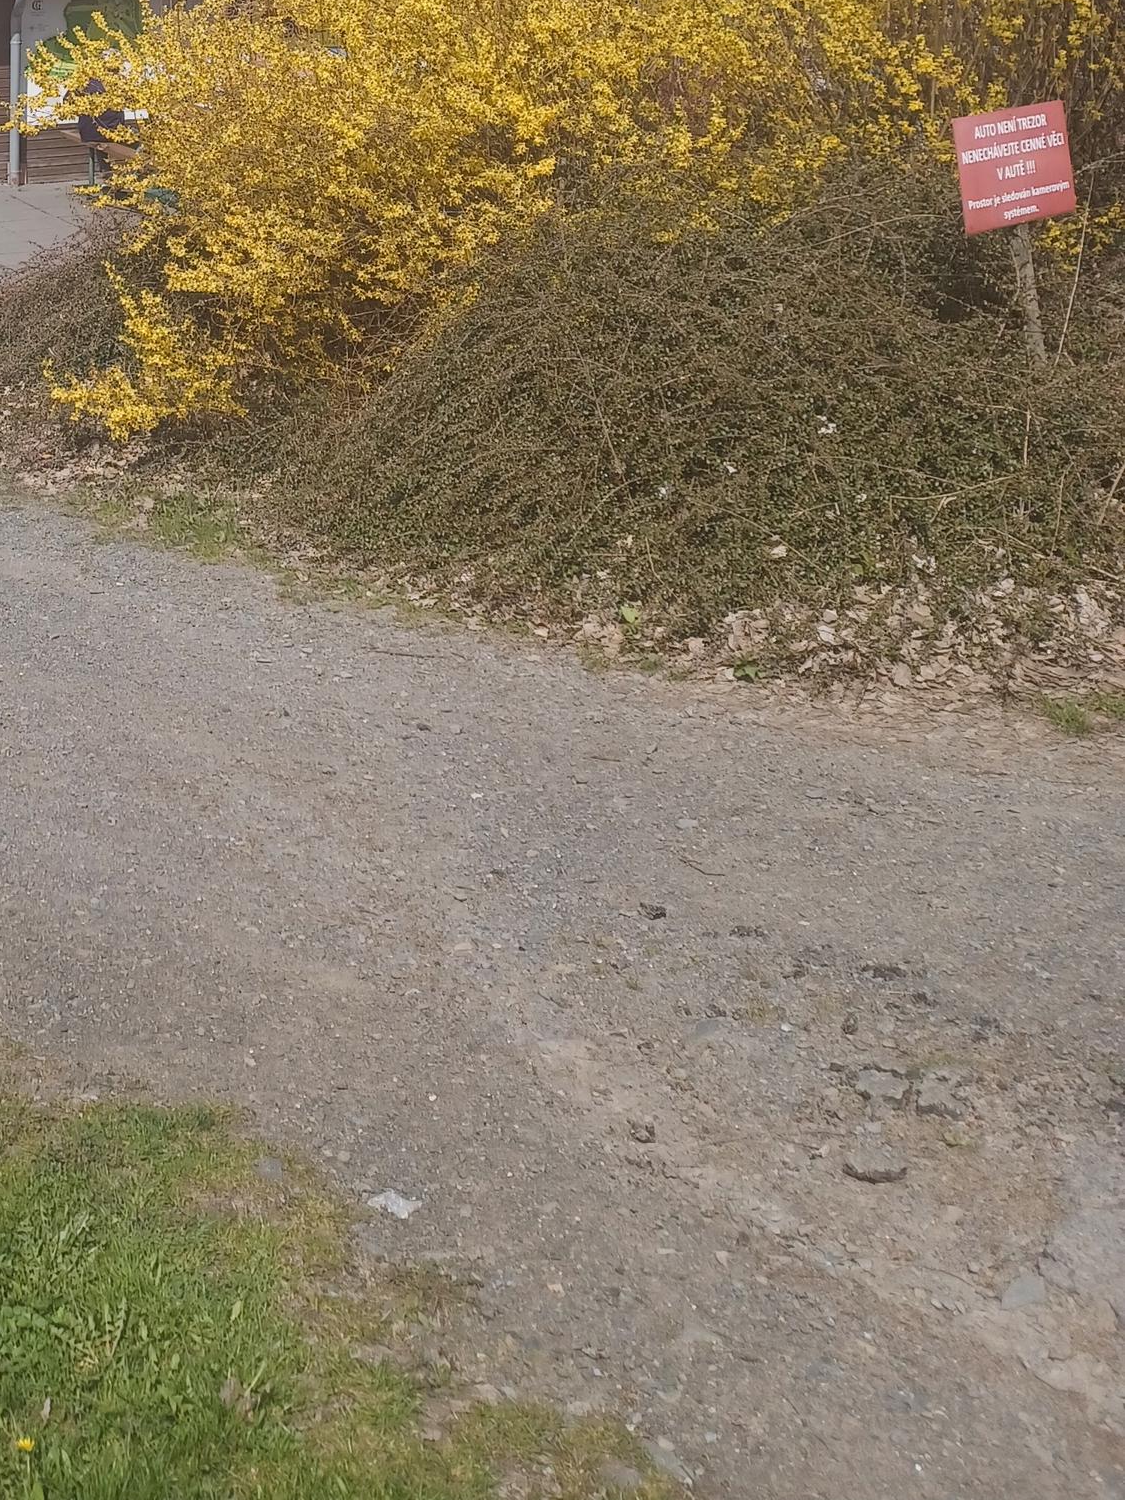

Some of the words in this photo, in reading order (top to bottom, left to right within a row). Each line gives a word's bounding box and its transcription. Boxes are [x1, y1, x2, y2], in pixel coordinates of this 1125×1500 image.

[974, 123, 996, 139] AUTO
[997, 116, 1017, 135] NENÍ
[1017, 113, 1047, 130] TREZOR
[961, 142, 1020, 165] NENECHÁVEJTE
[1021, 133, 1046, 153] CENNÉ
[1046, 130, 1065, 148] VĚCI
[996, 168, 1004, 181] V
[1005, 160, 1025, 179] AUTĚ
[1026, 160, 1036, 174] !!!
[968, 198, 993, 210] Prostor
[993, 195, 1001, 207] je
[1001, 188, 1031, 203] sledován
[1031, 180, 1070, 198] kamerovým
[1003, 204, 1040, 221] systémem.
